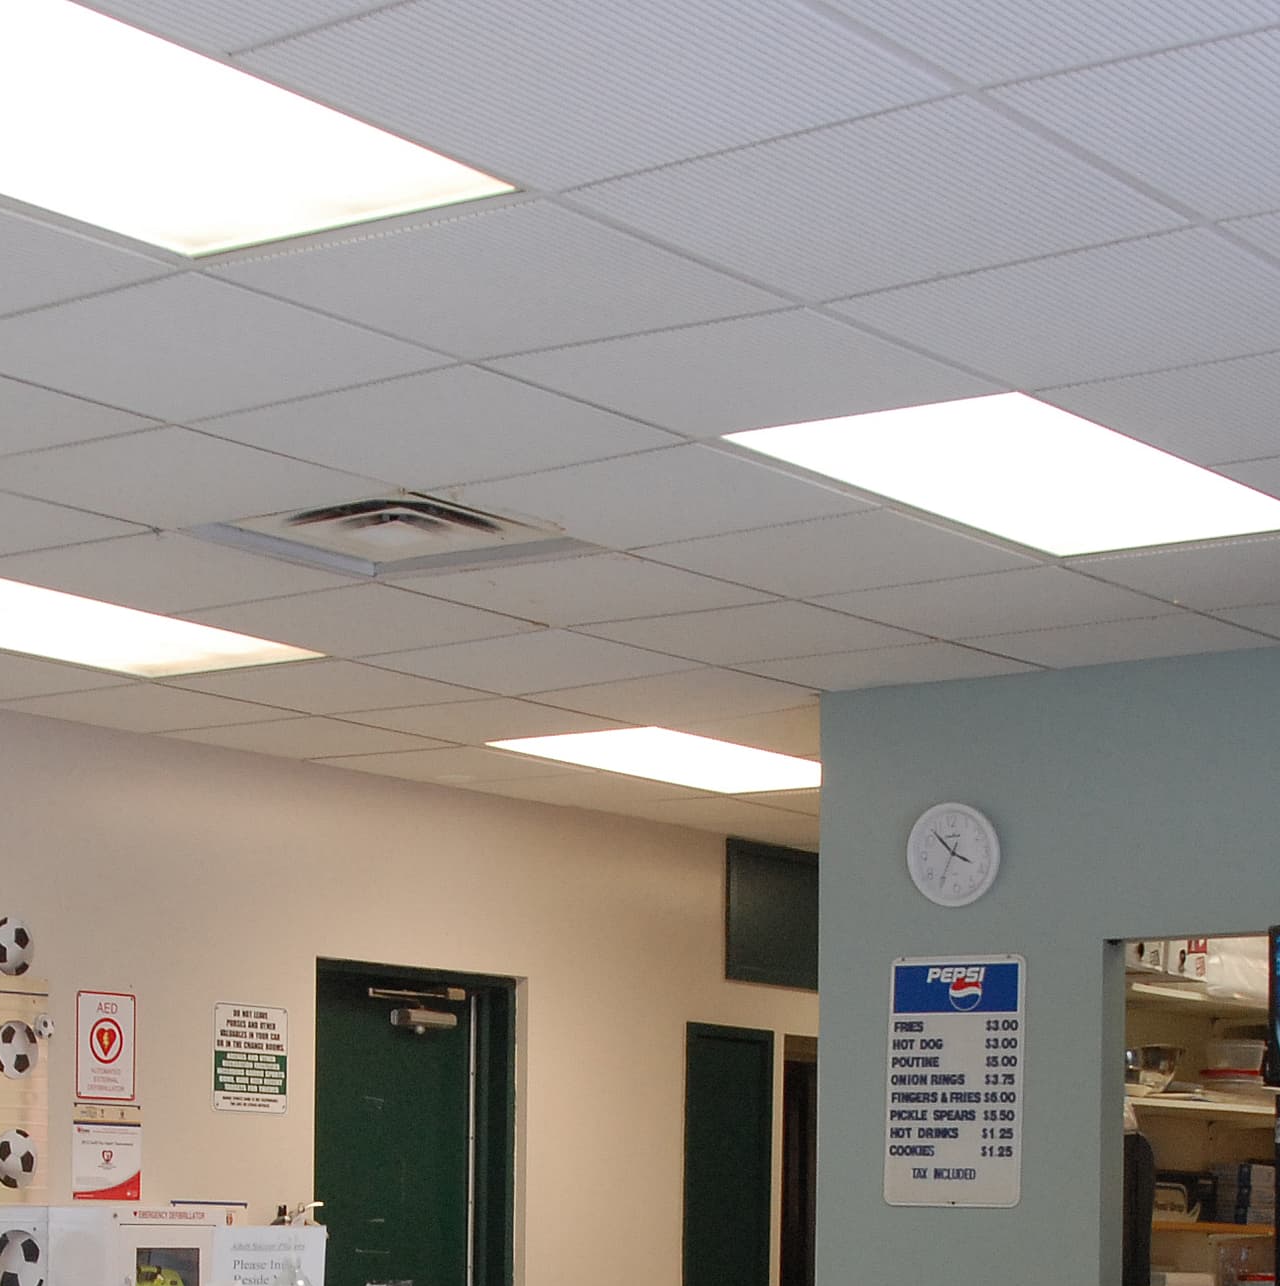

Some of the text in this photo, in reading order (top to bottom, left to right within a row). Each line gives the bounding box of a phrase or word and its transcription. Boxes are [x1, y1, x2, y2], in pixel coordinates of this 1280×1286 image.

[926, 967, 985, 983] PEPSI
[97, 1002, 118, 1014] AED
[233, 1009, 268, 1019] DO NOT LEAVE
[226, 1019, 246, 1028] PURSES
[260, 1022, 276, 1030] OTHER
[894, 1019, 1018, 1033] FRIES $3.00
[220, 1029, 247, 1038] VALUABLES
[244, 1041, 264, 1050] CHANGE
[892, 1038, 1017, 1050] HOT DOG $3.00
[892, 1057, 939, 1068] POUTINE
[891, 1074, 927, 1085] ONION
[930, 1074, 965, 1085] RINGS
[891, 1092, 938, 1103] FINGERS
[940, 1092, 948, 1103] &
[949, 1092, 981, 1103] FRIES
[890, 1110, 927, 1121] PICKLE
[933, 1110, 976, 1121] SPEARS
[890, 1127, 1014, 1139] HOT DRINKS $1.25
[889, 1145, 1013, 1157] COOKIES $1.25
[912, 1168, 976, 1180] TAX INCLUDED
[138, 1210, 205, 1219] EMERGENCY DEFIBRILLATOR
[233, 1259, 267, 1270] Please
